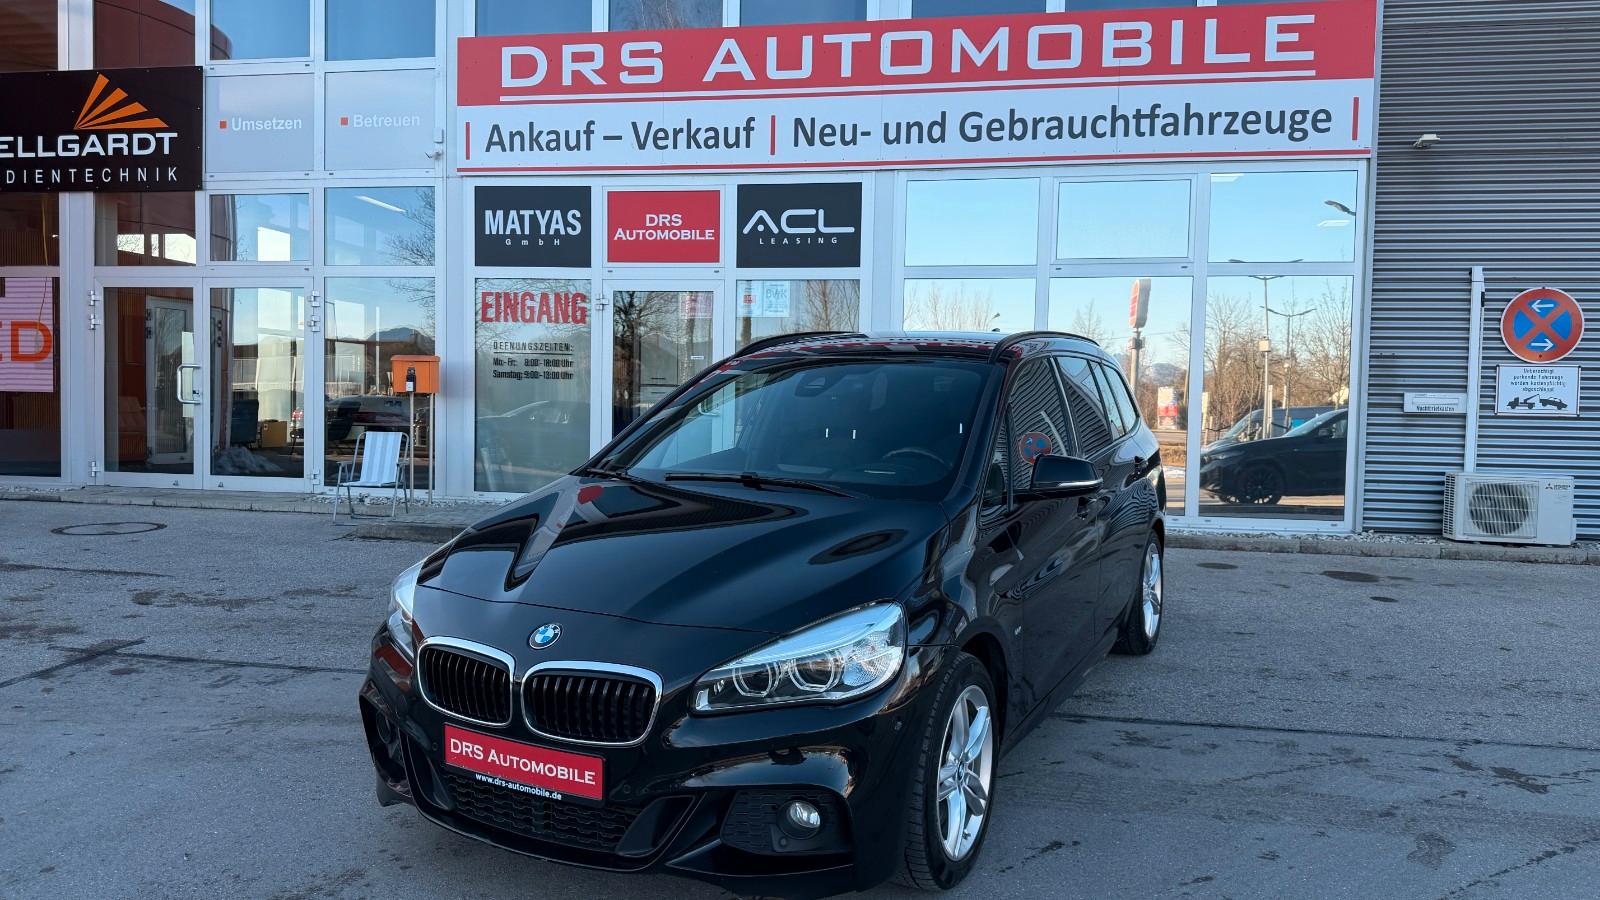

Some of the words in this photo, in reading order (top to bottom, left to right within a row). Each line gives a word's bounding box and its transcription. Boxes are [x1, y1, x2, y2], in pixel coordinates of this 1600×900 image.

[501, 41, 663, 88] DRS
[702, 15, 1316, 82] AUTOMOBILE
[231, 117, 302, 132] Umsetzen
[353, 114, 421, 128] Betreuen
[485, 120, 595, 152] Ankauf
[632, 117, 755, 150] Verkauf
[793, 117, 871, 147] Neu-
[884, 111, 947, 145] und
[958, 103, 1333, 142] Gebrauchtfahrzeuge
[6, 167, 178, 184] DIENTECHNIK
[484, 209, 582, 235] MATYAS
[645, 213, 683, 227] DRS
[743, 209, 855, 235] ACL
[759, 237, 838, 245] LEASING
[481, 291, 588, 324] EINGANG
[450, 737, 484, 760] DRS
[487, 749, 596, 785] AUTOMOBILE
[475, 772, 562, 801] www.drs-automobile.de
